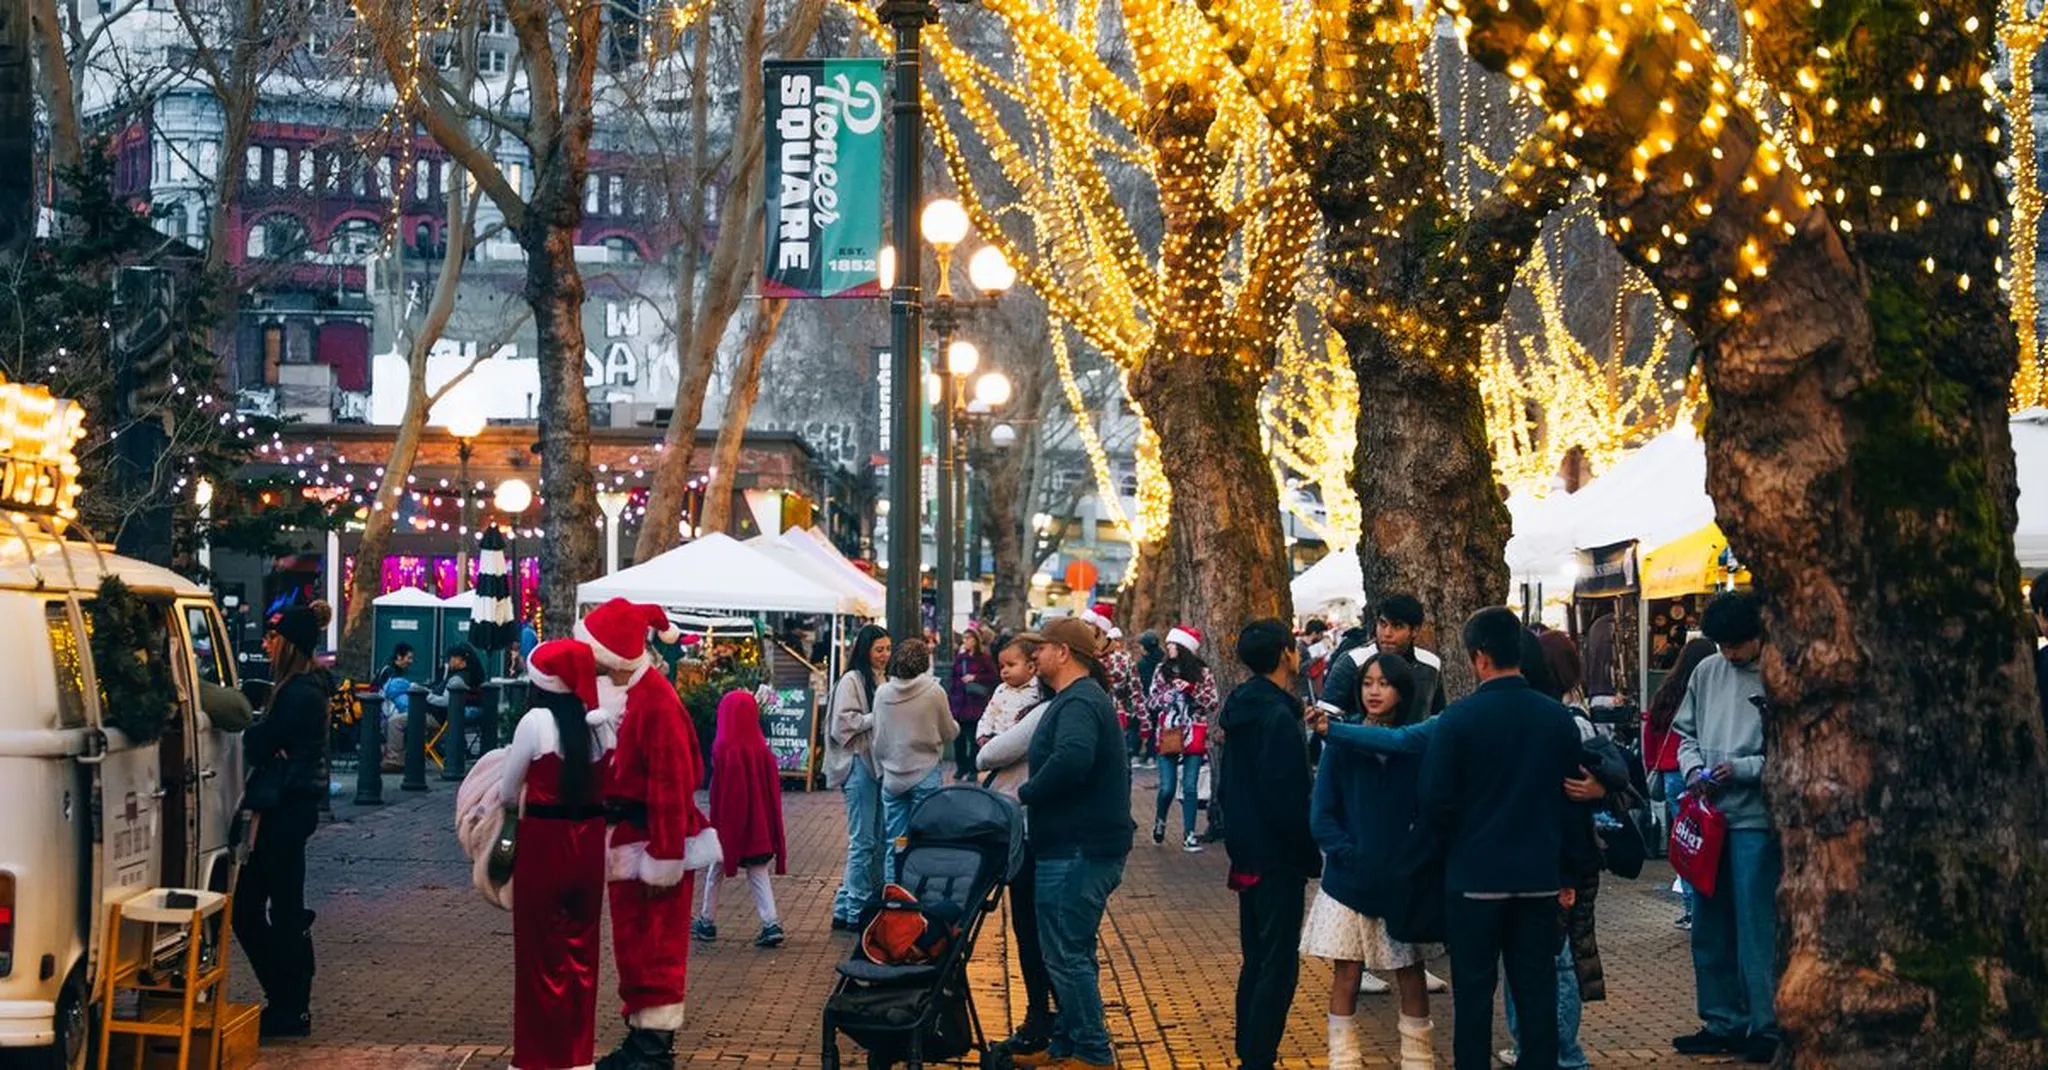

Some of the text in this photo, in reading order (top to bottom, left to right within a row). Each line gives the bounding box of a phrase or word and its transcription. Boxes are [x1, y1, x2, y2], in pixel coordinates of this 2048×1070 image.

[776, 75, 811, 270] SQUARE
[813, 73, 883, 229] Pioneer
[828, 259, 877, 272] 1852
[838, 247, 866, 256] EST.
